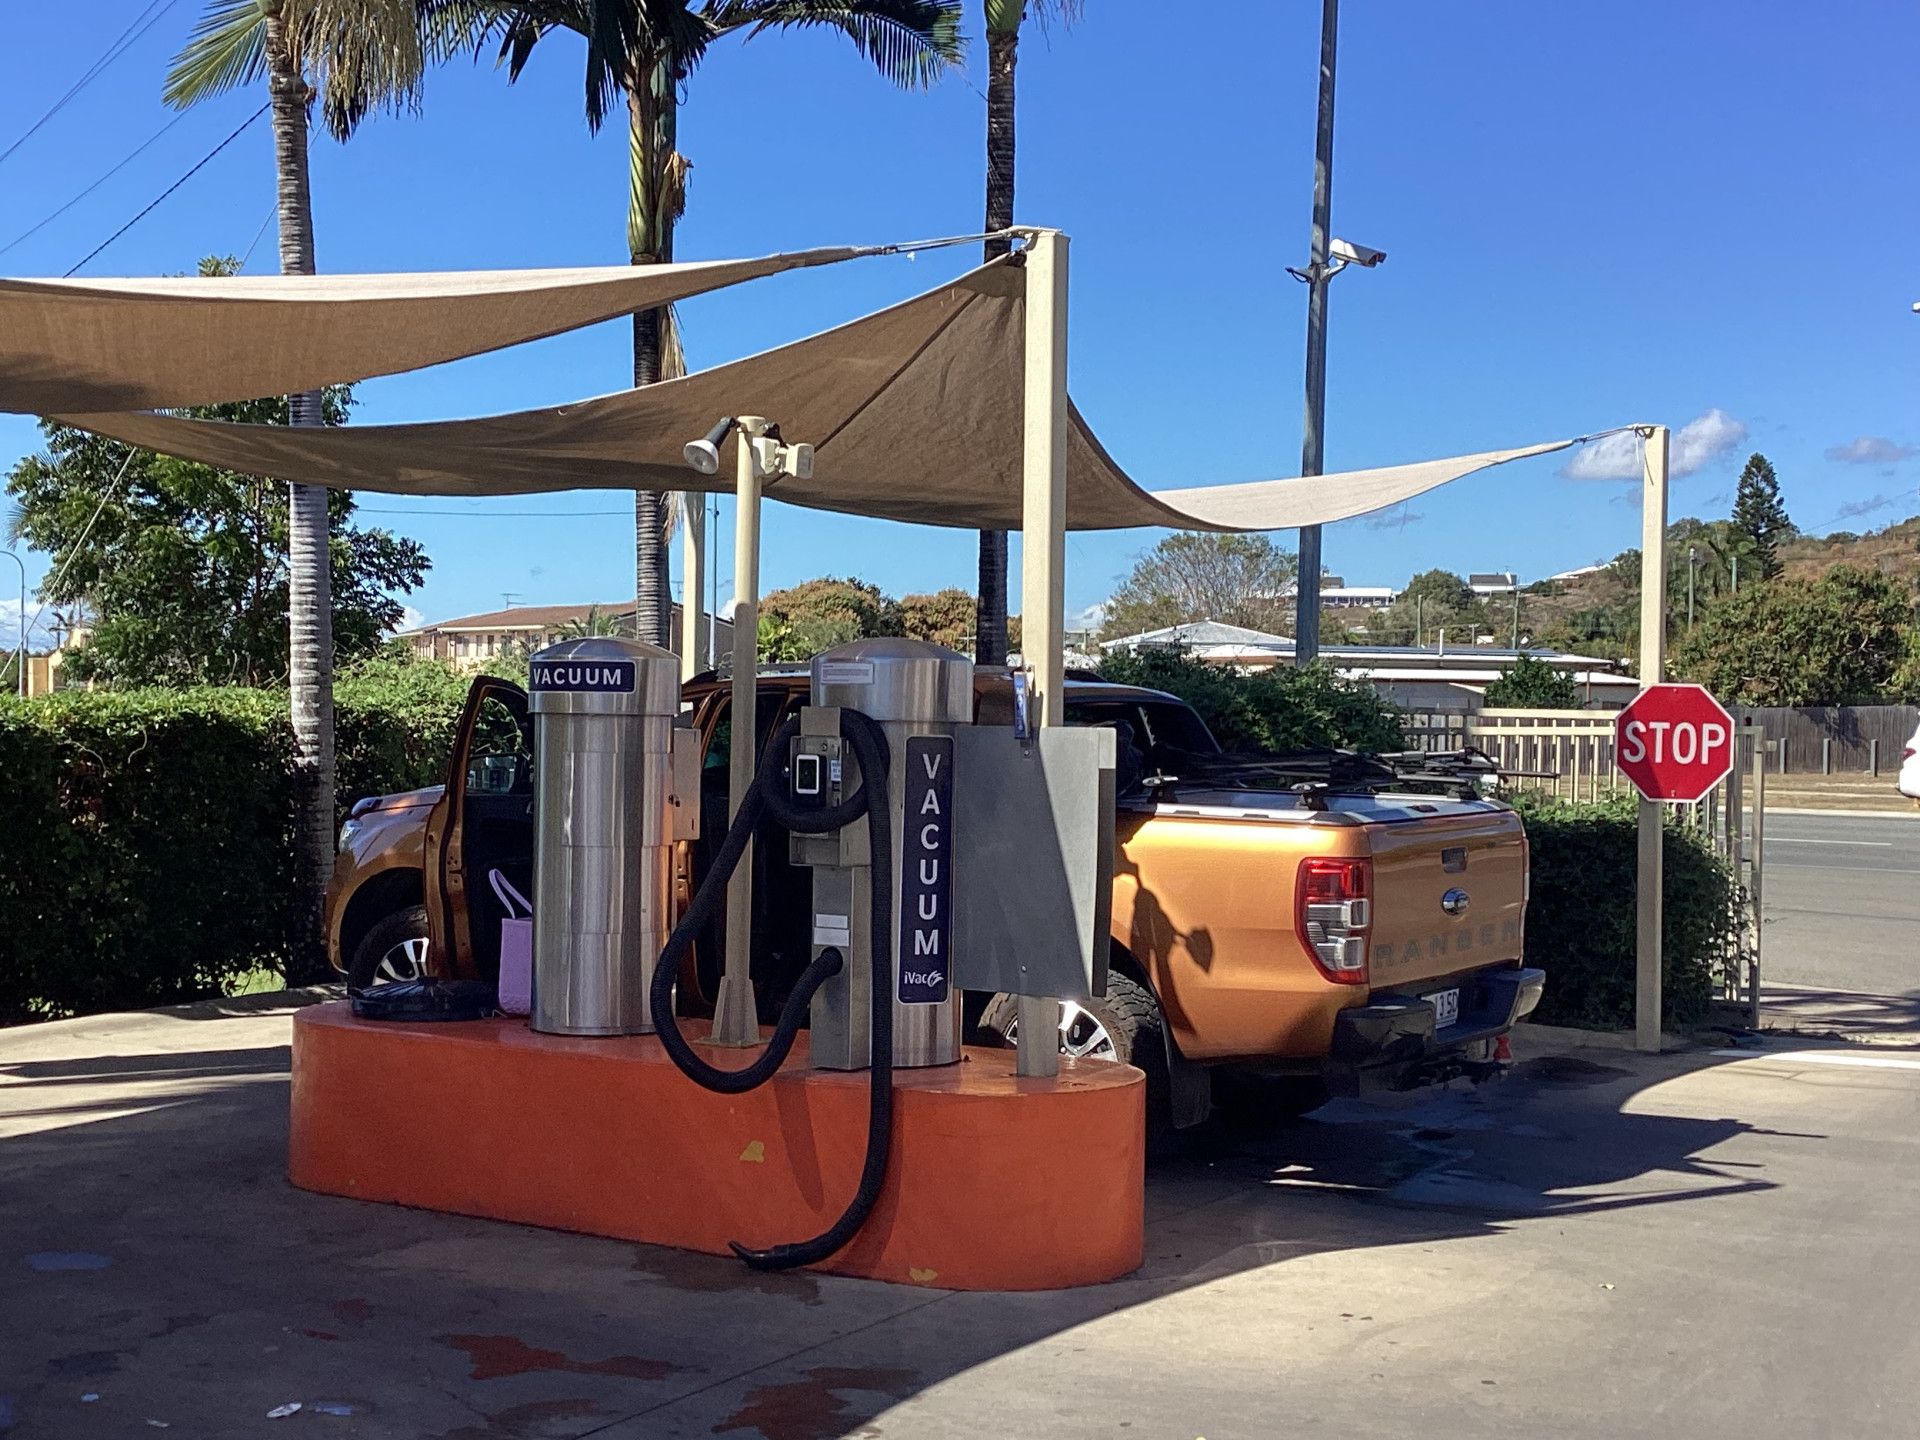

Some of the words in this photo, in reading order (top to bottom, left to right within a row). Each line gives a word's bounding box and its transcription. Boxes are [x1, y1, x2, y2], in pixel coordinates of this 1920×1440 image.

[533, 668, 621, 685] VACUUM
[1622, 720, 1726, 765] STOP
[914, 753, 941, 955] VACUUM
